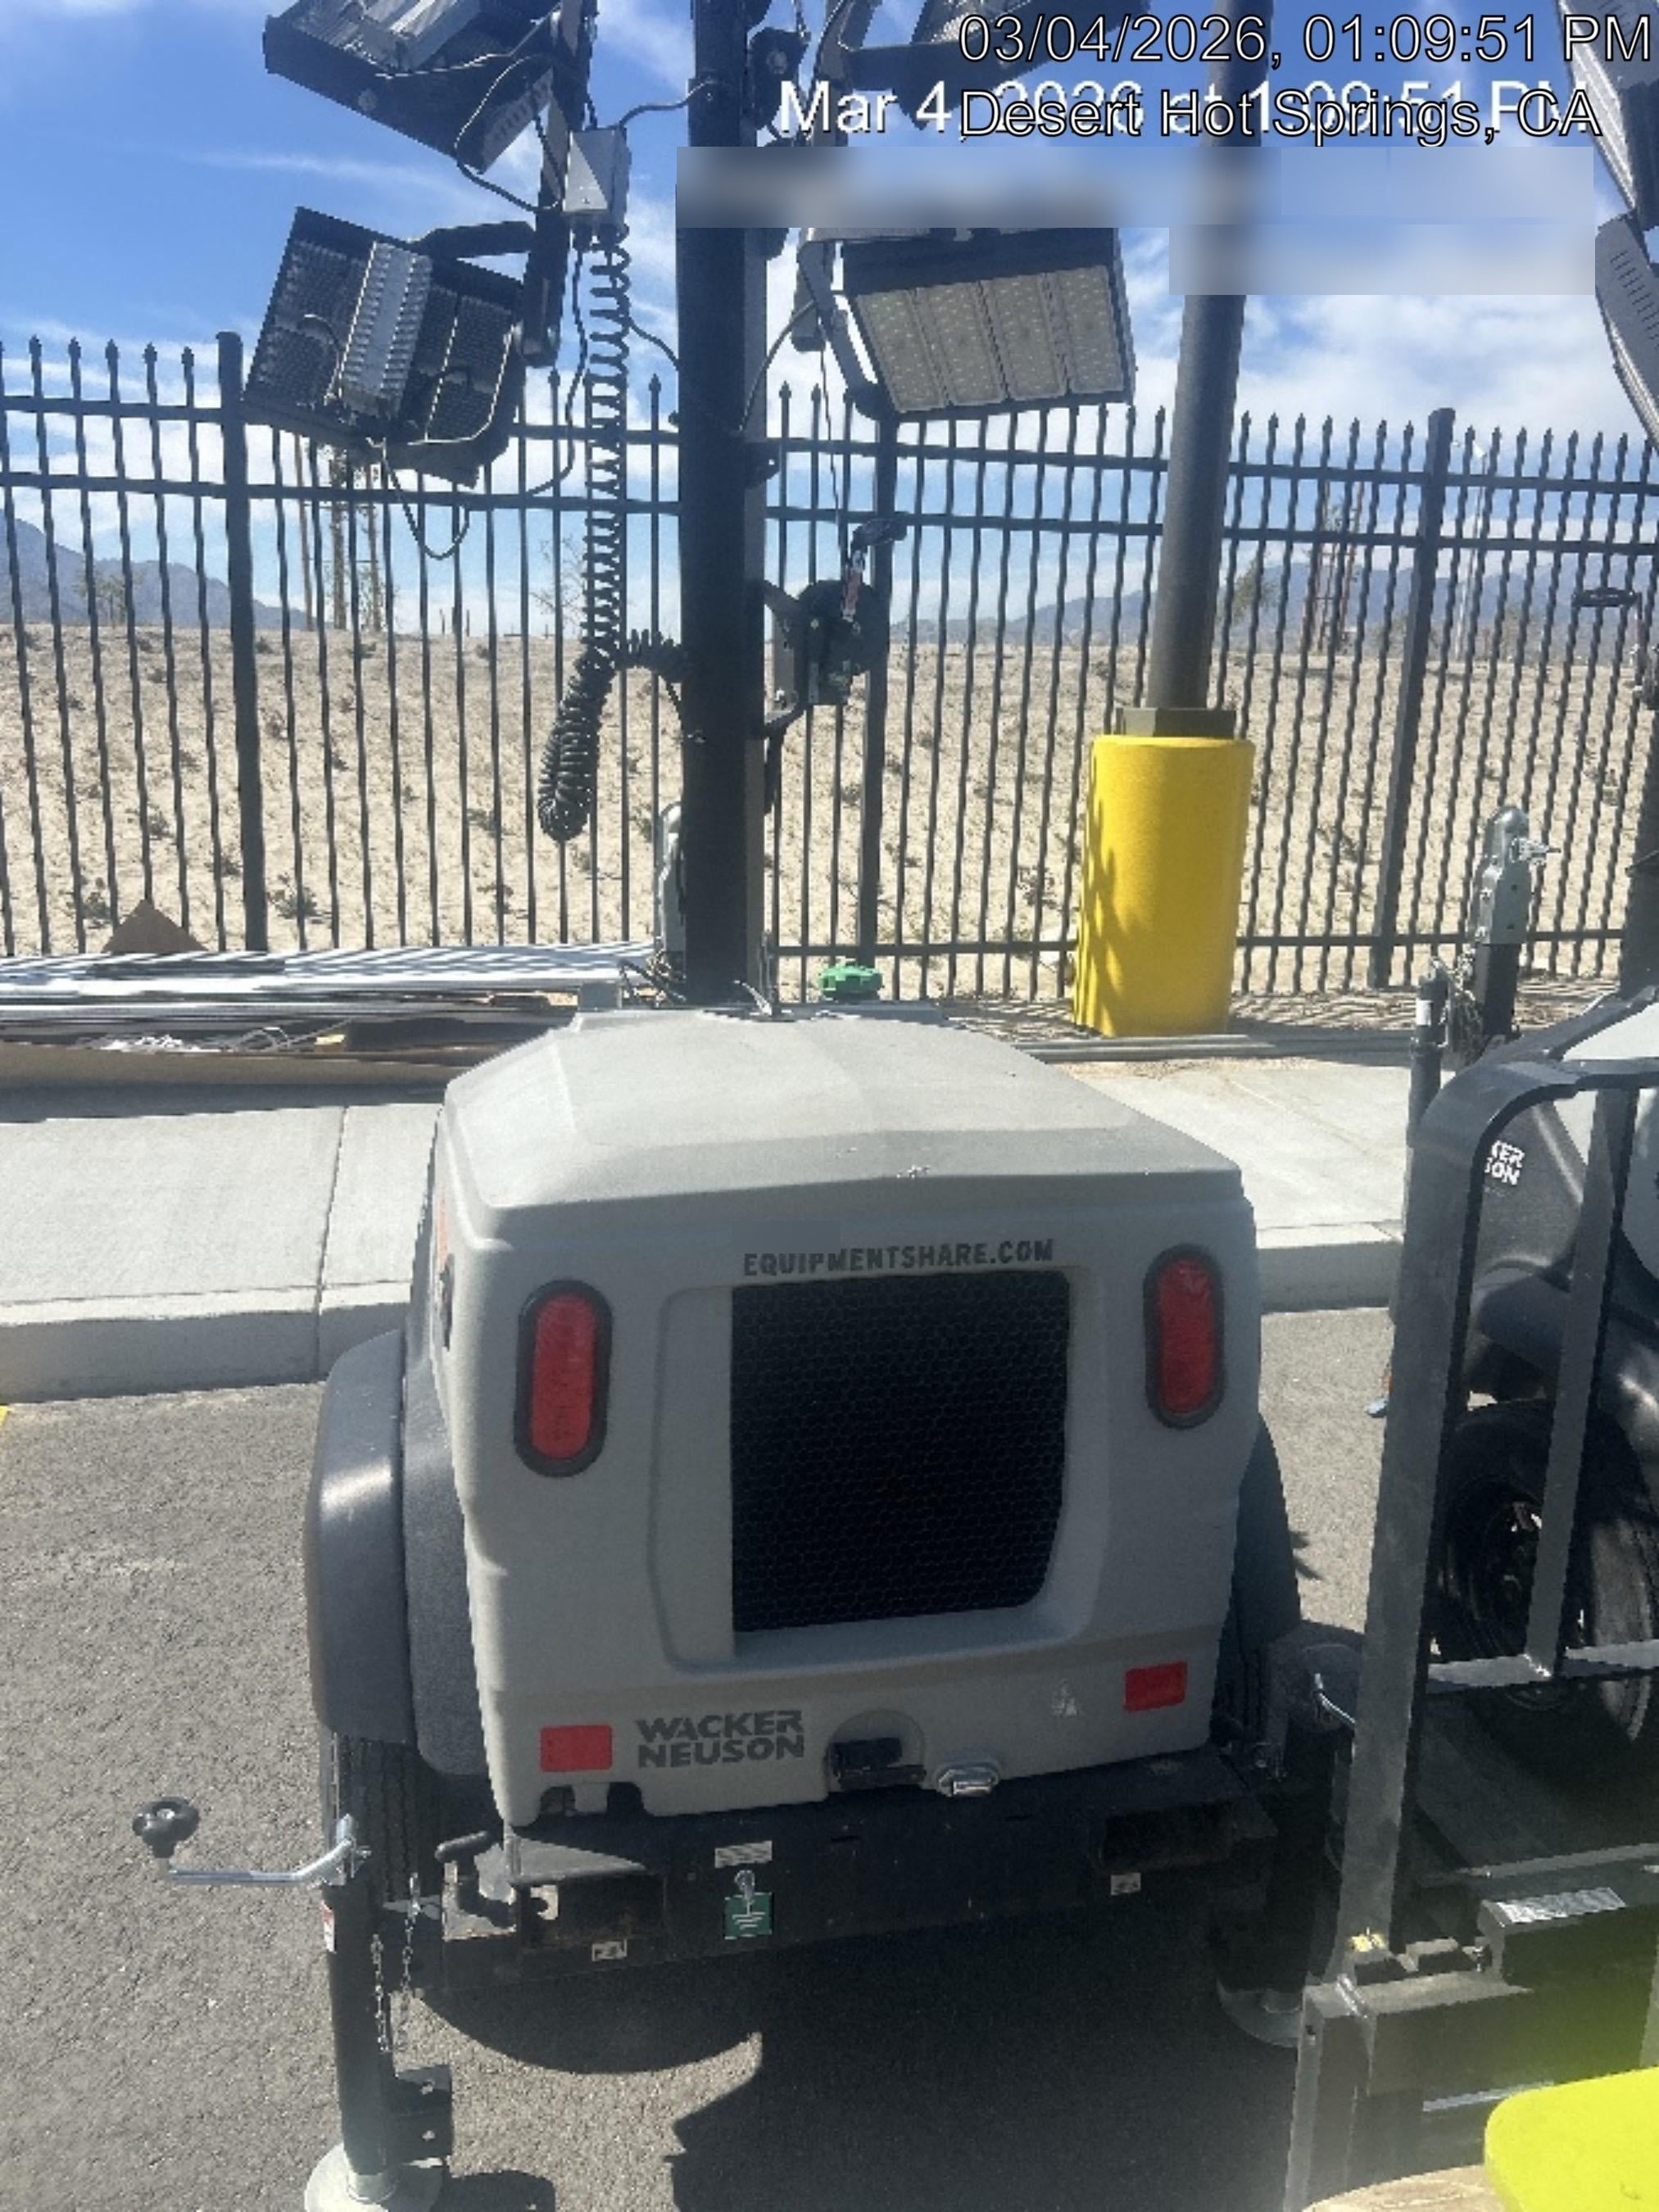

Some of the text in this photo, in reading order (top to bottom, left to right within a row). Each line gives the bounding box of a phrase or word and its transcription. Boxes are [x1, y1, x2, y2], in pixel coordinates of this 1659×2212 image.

[743, 1238, 1054, 1276] EQUIPMENTSHARE.COM
[634, 1710, 805, 1743] WACKER
[638, 1734, 805, 1769] NEUSON
